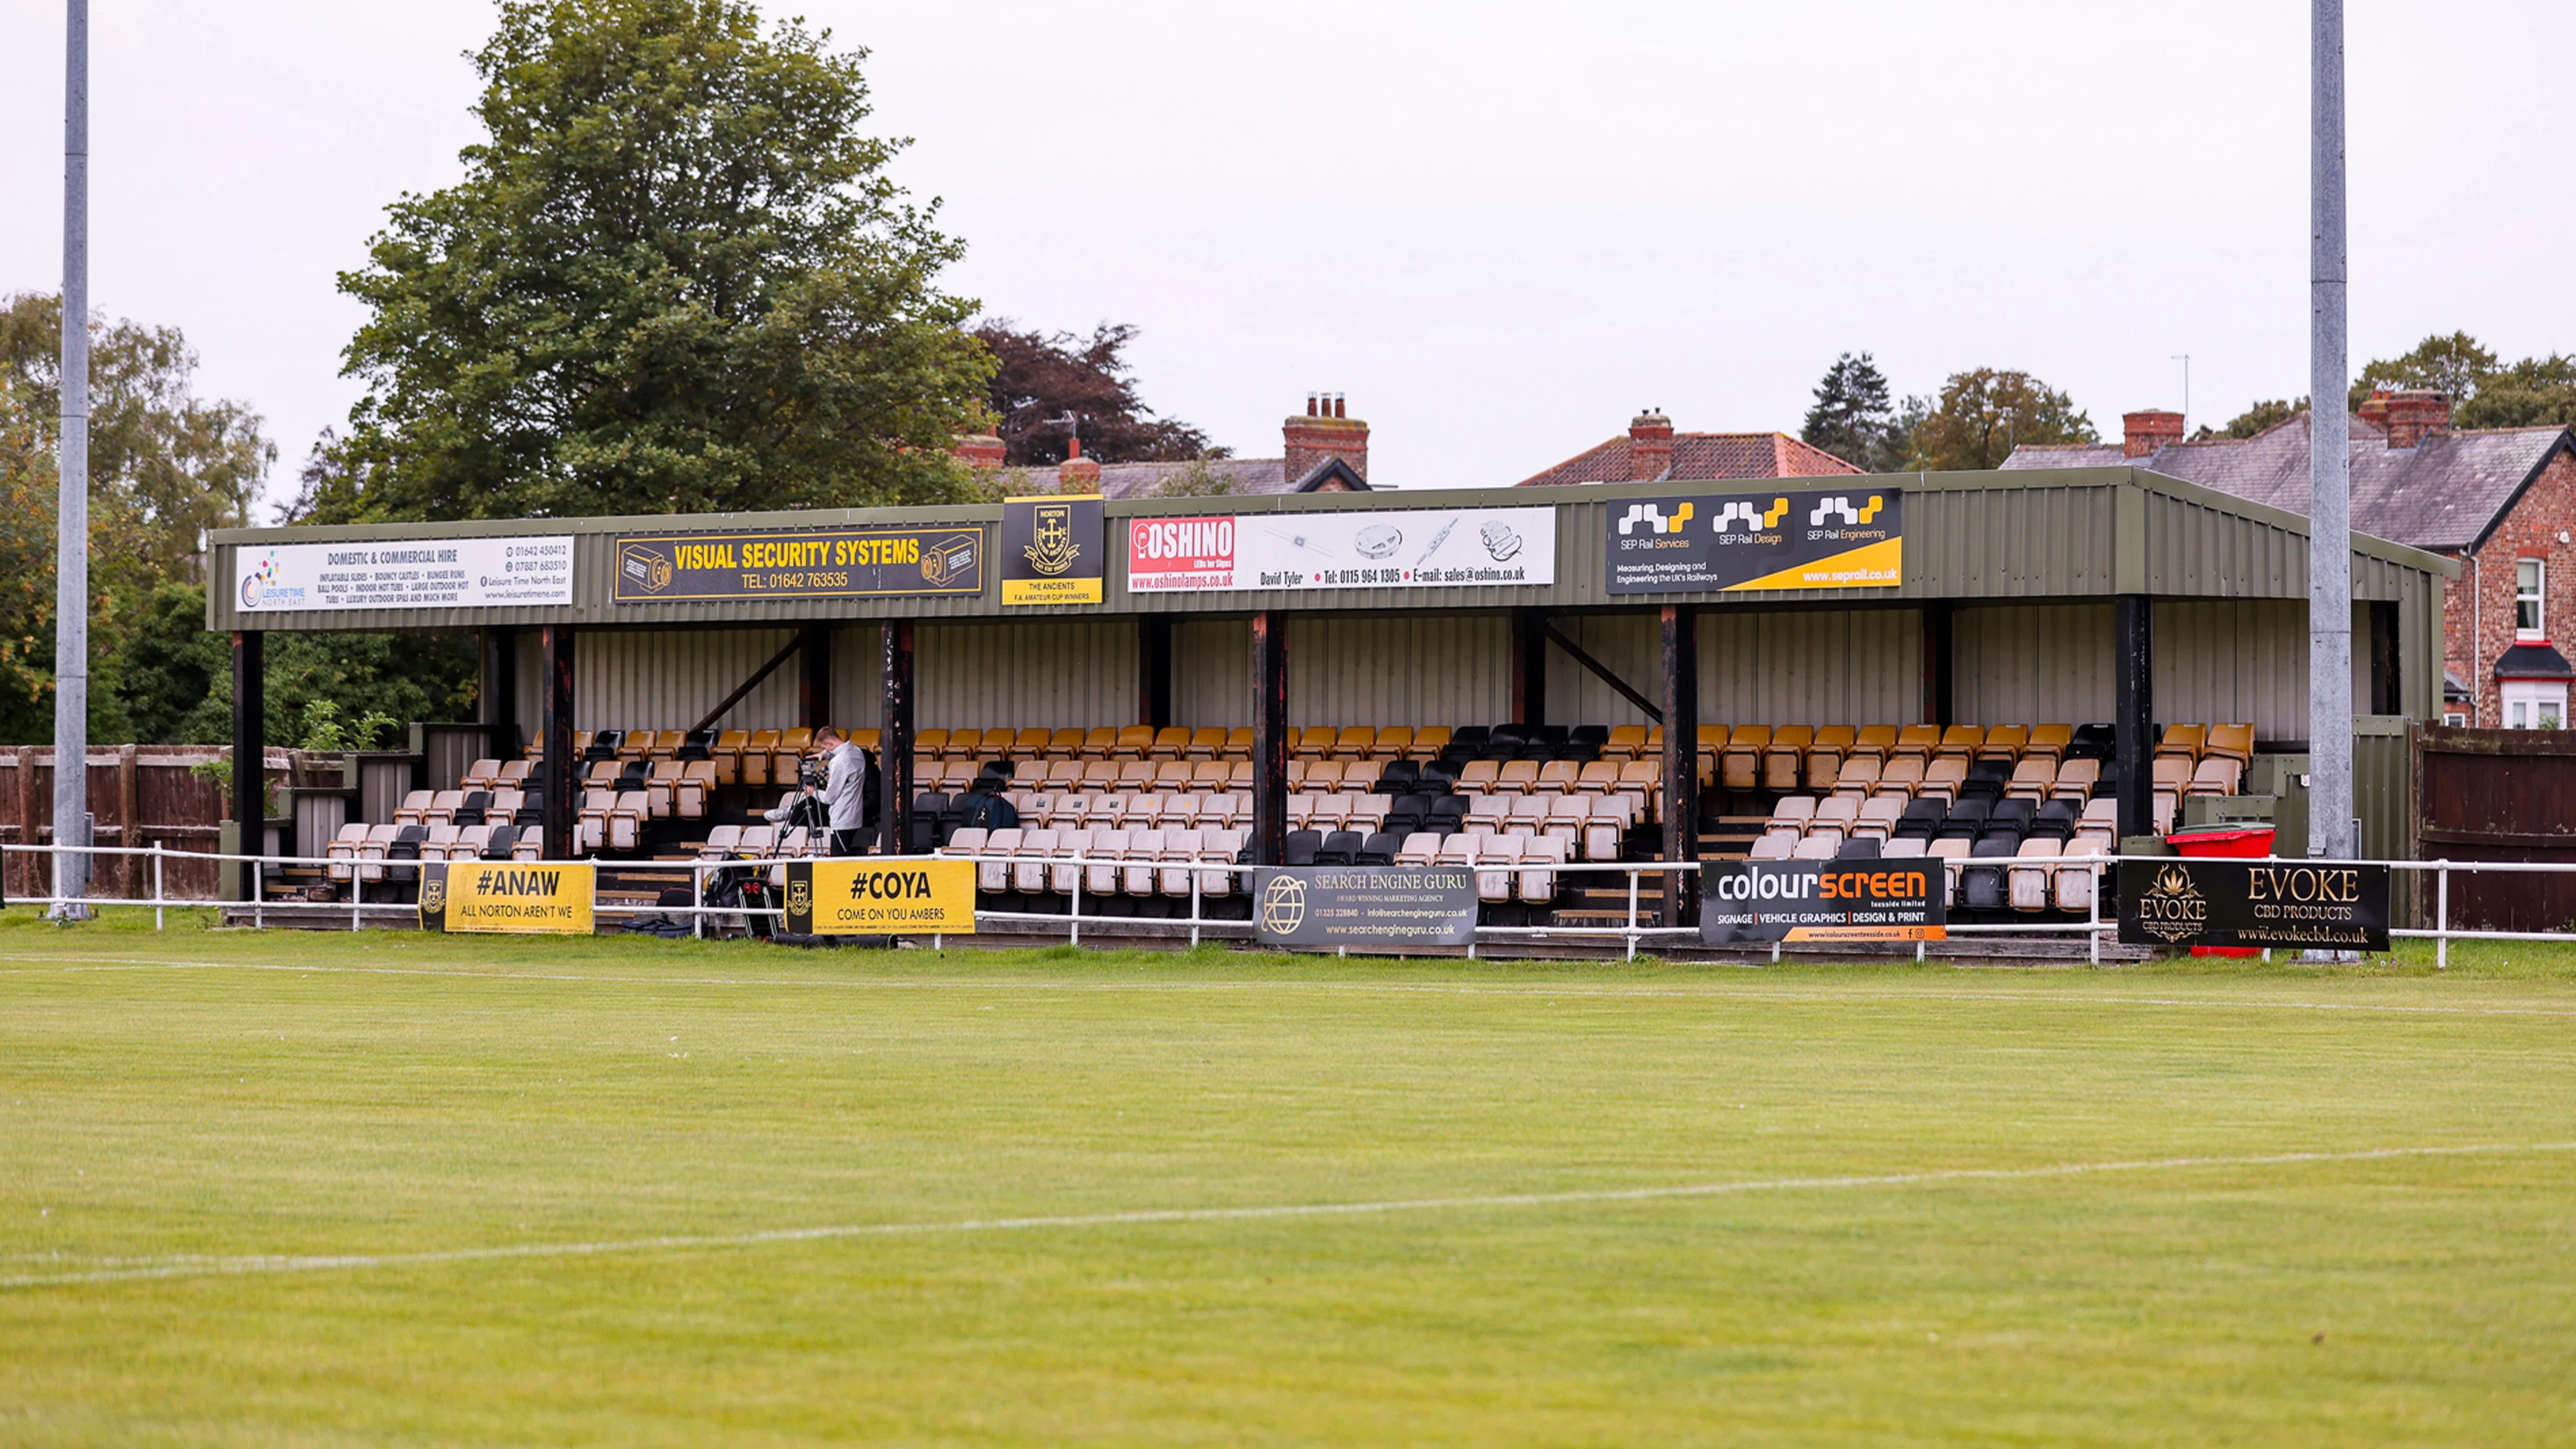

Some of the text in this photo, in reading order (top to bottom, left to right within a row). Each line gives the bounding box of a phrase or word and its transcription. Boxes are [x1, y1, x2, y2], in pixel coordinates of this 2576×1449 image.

[1148, 521, 1233, 559] OSHINO
[1719, 533, 1782, 545] SEP Rail Design
[1807, 528, 1886, 541] SEP Rail Engineering
[515, 546, 538, 556] 01642
[1621, 538, 1690, 551] SEP Rail Services
[328, 549, 458, 566] DOMESTIC & COMMERCIAL HIRE
[674, 544, 738, 569] VISUAL
[742, 541, 831, 568] SECURITY
[835, 539, 920, 566] SYSTEMS
[1413, 566, 1525, 582] E-mail: sales@oshino.co.uk
[1617, 562, 1707, 574] Measuring, Designing and
[319, 569, 465, 581] INFLATABLE SLIDES BOUNCY CASTLES BUNGEE RUNS
[489, 575, 567, 586] Leisure Time North East
[742, 572, 848, 588] TEL: 01642 763535
[1133, 571, 1233, 590] www.oshinolamps.co.uk
[1261, 571, 1303, 588] David Tyler
[1324, 569, 1400, 584] Tel: 0115 964 1305
[1617, 574, 1658, 586] Engineering
[1659, 573, 1671, 582] the
[1687, 573, 1718, 583] Railways
[1803, 568, 1898, 584] www.seprail.co.uk
[318, 581, 469, 594] BALL POOLS INDOOR HOT TUBS LARGE OUTDOOR HOT
[1029, 581, 1075, 591] THE ANCIENTS
[262, 587, 306, 599] LEISURE TIME
[325, 595, 339, 604] TUBS
[346, 594, 367, 604] LUXURY
[368, 594, 395, 603] OUTDOOR
[410, 594, 422, 602] AND
[423, 593, 440, 602] MUCH
[441, 593, 458, 601] MORE
[1052, 593, 1063, 601] CUP
[1065, 592, 1090, 600] WINNERS
[477, 870, 561, 896] #ANAW
[850, 872, 932, 899] #COYA
[1315, 874, 1467, 890] SEARCH ENGINE GURU
[1718, 866, 1926, 900] colourscreen
[2248, 868, 2360, 902] EVOKE
[1901, 899, 1926, 908] limited
[2140, 898, 2208, 921] EVOKE
[461, 905, 572, 918] ALL NORTON AREN'T WE
[837, 908, 945, 921] COME ON YOU AMBERS
[2254, 904, 2353, 921] CBD PRODUCTS
[1717, 912, 1925, 925] SIGNAGE VEHICLE GRAPHICS DESIGN & PRINT
[1325, 923, 1455, 937] www.searchengineguru.co.uk
[2142, 921, 2203, 932] CBD PRODUCTS
[2238, 926, 2368, 944] www.evokecbd.co.uk
